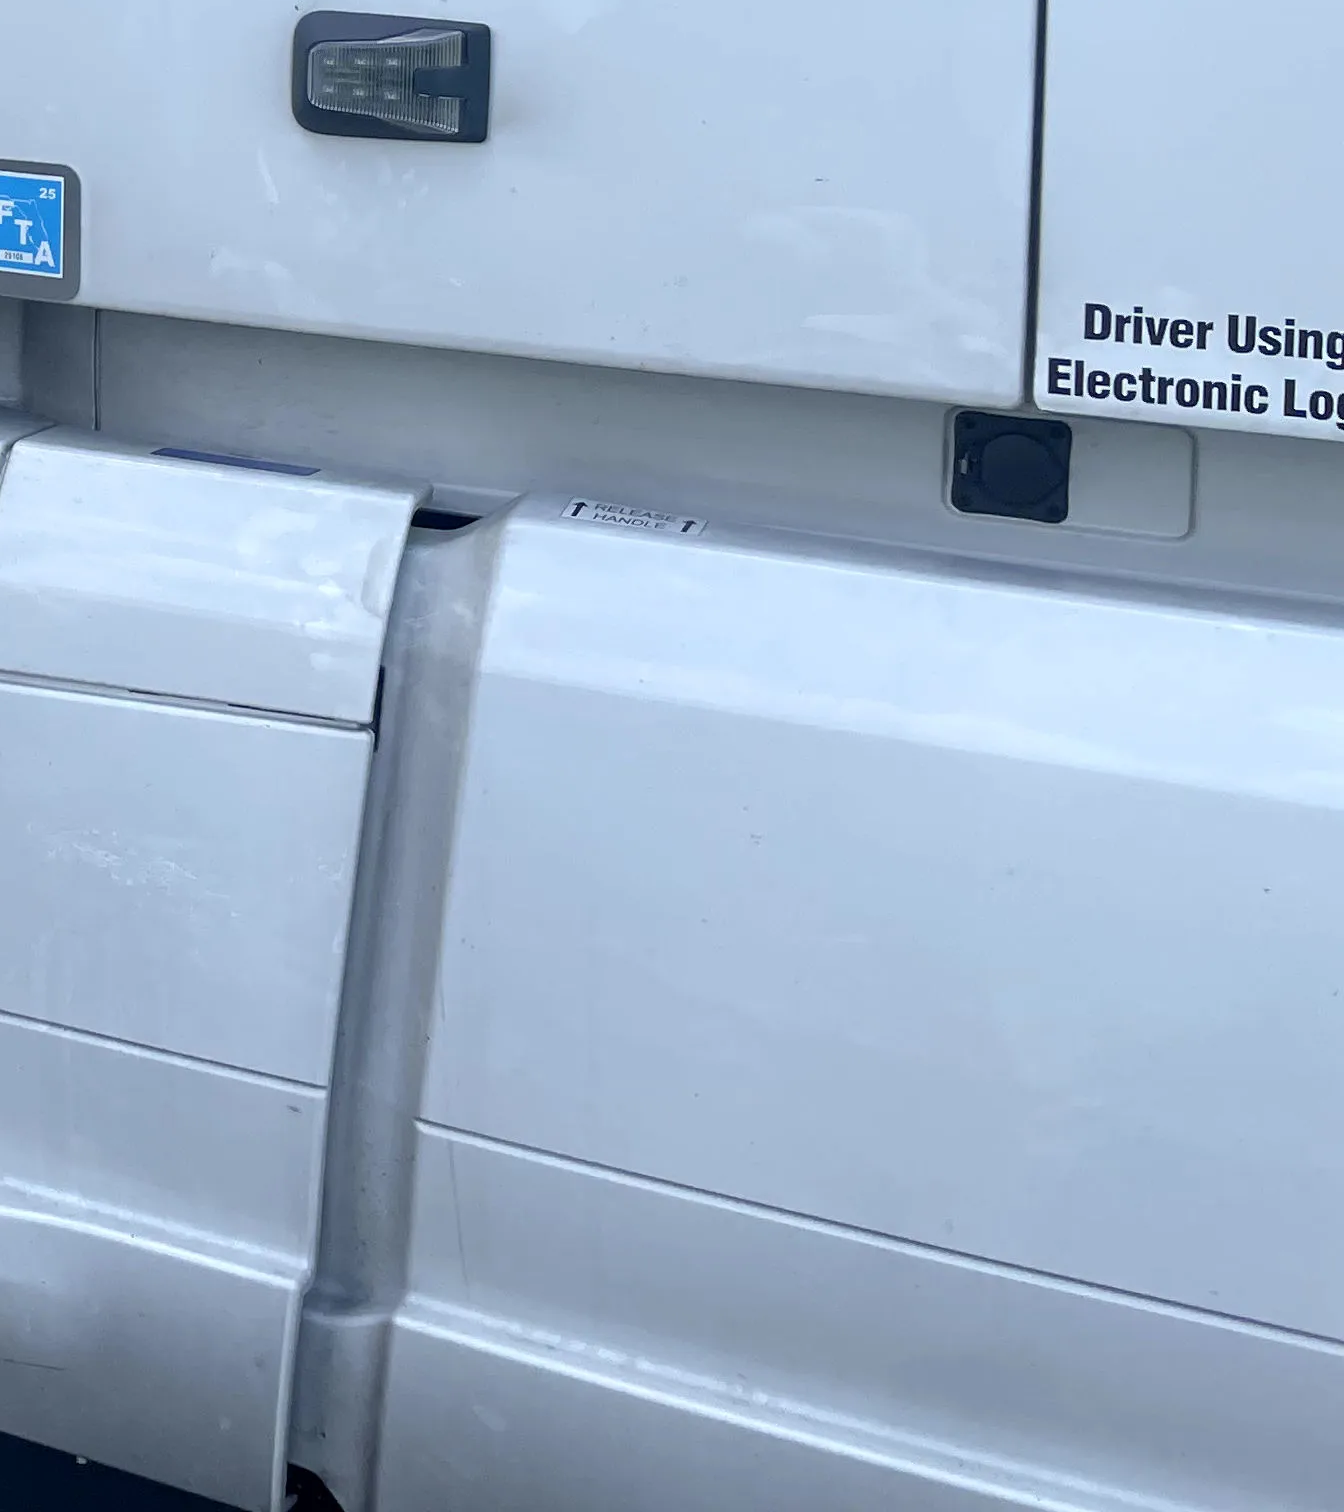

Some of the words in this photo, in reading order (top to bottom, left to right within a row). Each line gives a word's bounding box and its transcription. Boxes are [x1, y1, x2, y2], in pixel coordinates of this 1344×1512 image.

[39, 188, 56, 199] 25
[1084, 302, 1213, 350] Driver
[1227, 314, 1344, 371] Using
[1048, 357, 1268, 414] Electronic
[594, 503, 675, 522] RELEASE
